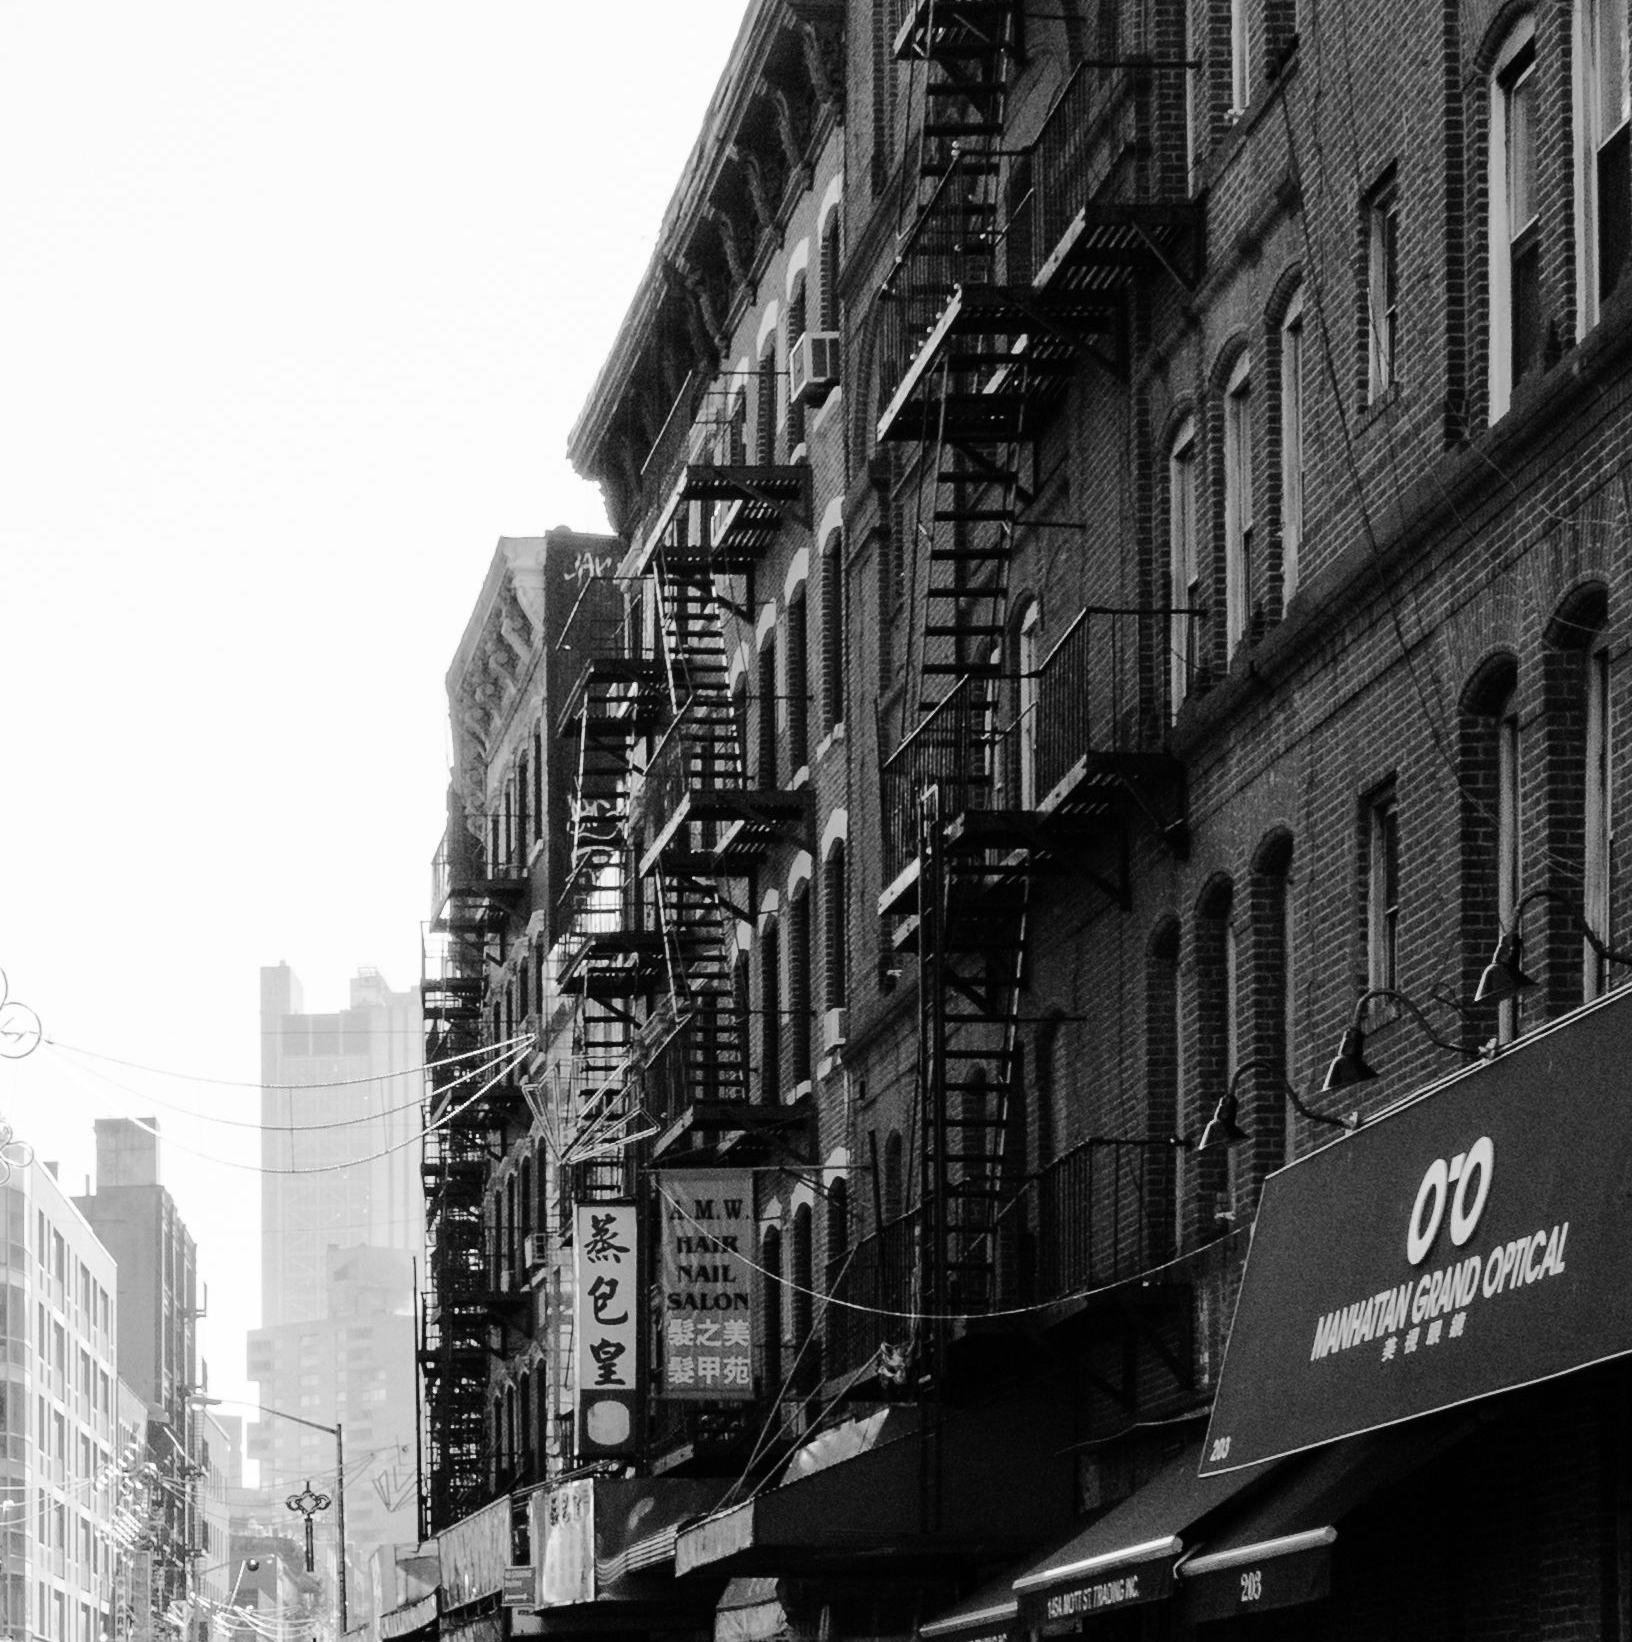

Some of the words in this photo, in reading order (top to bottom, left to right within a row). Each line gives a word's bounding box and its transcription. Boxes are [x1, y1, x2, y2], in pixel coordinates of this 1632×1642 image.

[677, 1236, 739, 1254] HAIR
[678, 1265, 737, 1283] NAIL
[583, 1212, 631, 1386] 蒸包皇
[666, 1292, 750, 1311] SALON
[1310, 1281, 1414, 1361] MANHATTAN
[1411, 1255, 1481, 1324] GRAND
[1482, 1222, 1570, 1299] OPTICAL
[1240, 1570, 1262, 1602] 203
